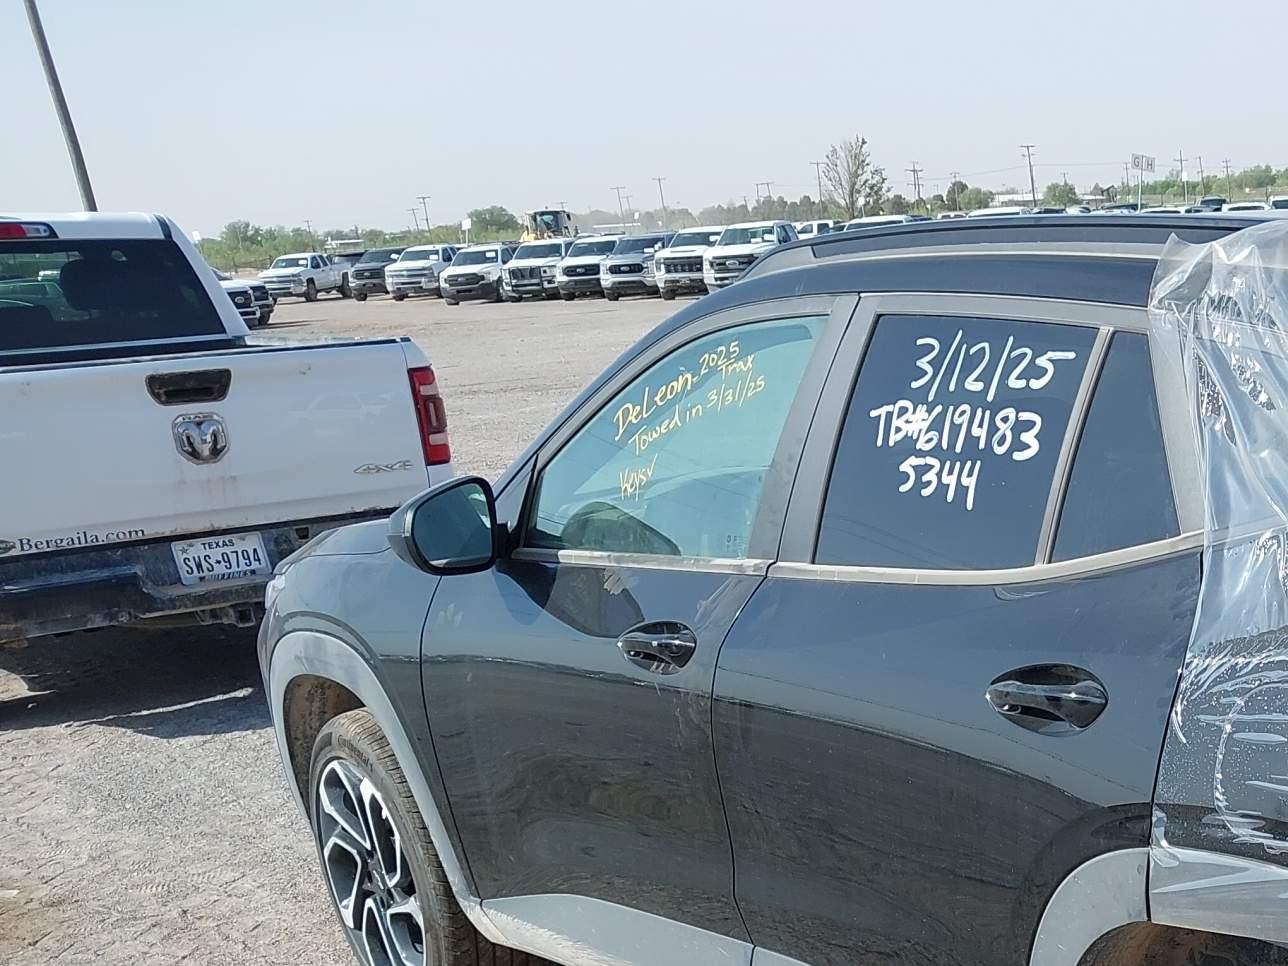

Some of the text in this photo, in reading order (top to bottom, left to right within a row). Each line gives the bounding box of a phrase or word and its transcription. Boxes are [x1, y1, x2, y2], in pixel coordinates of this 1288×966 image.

[699, 340, 740, 376] 2025
[911, 329, 1076, 402] 3/12/25
[628, 374, 766, 456] Towed in 3/31/25
[898, 455, 982, 511] 5344
[17, 527, 146, 552] Bergaila.com
[201, 538, 235, 551] TEXAS
